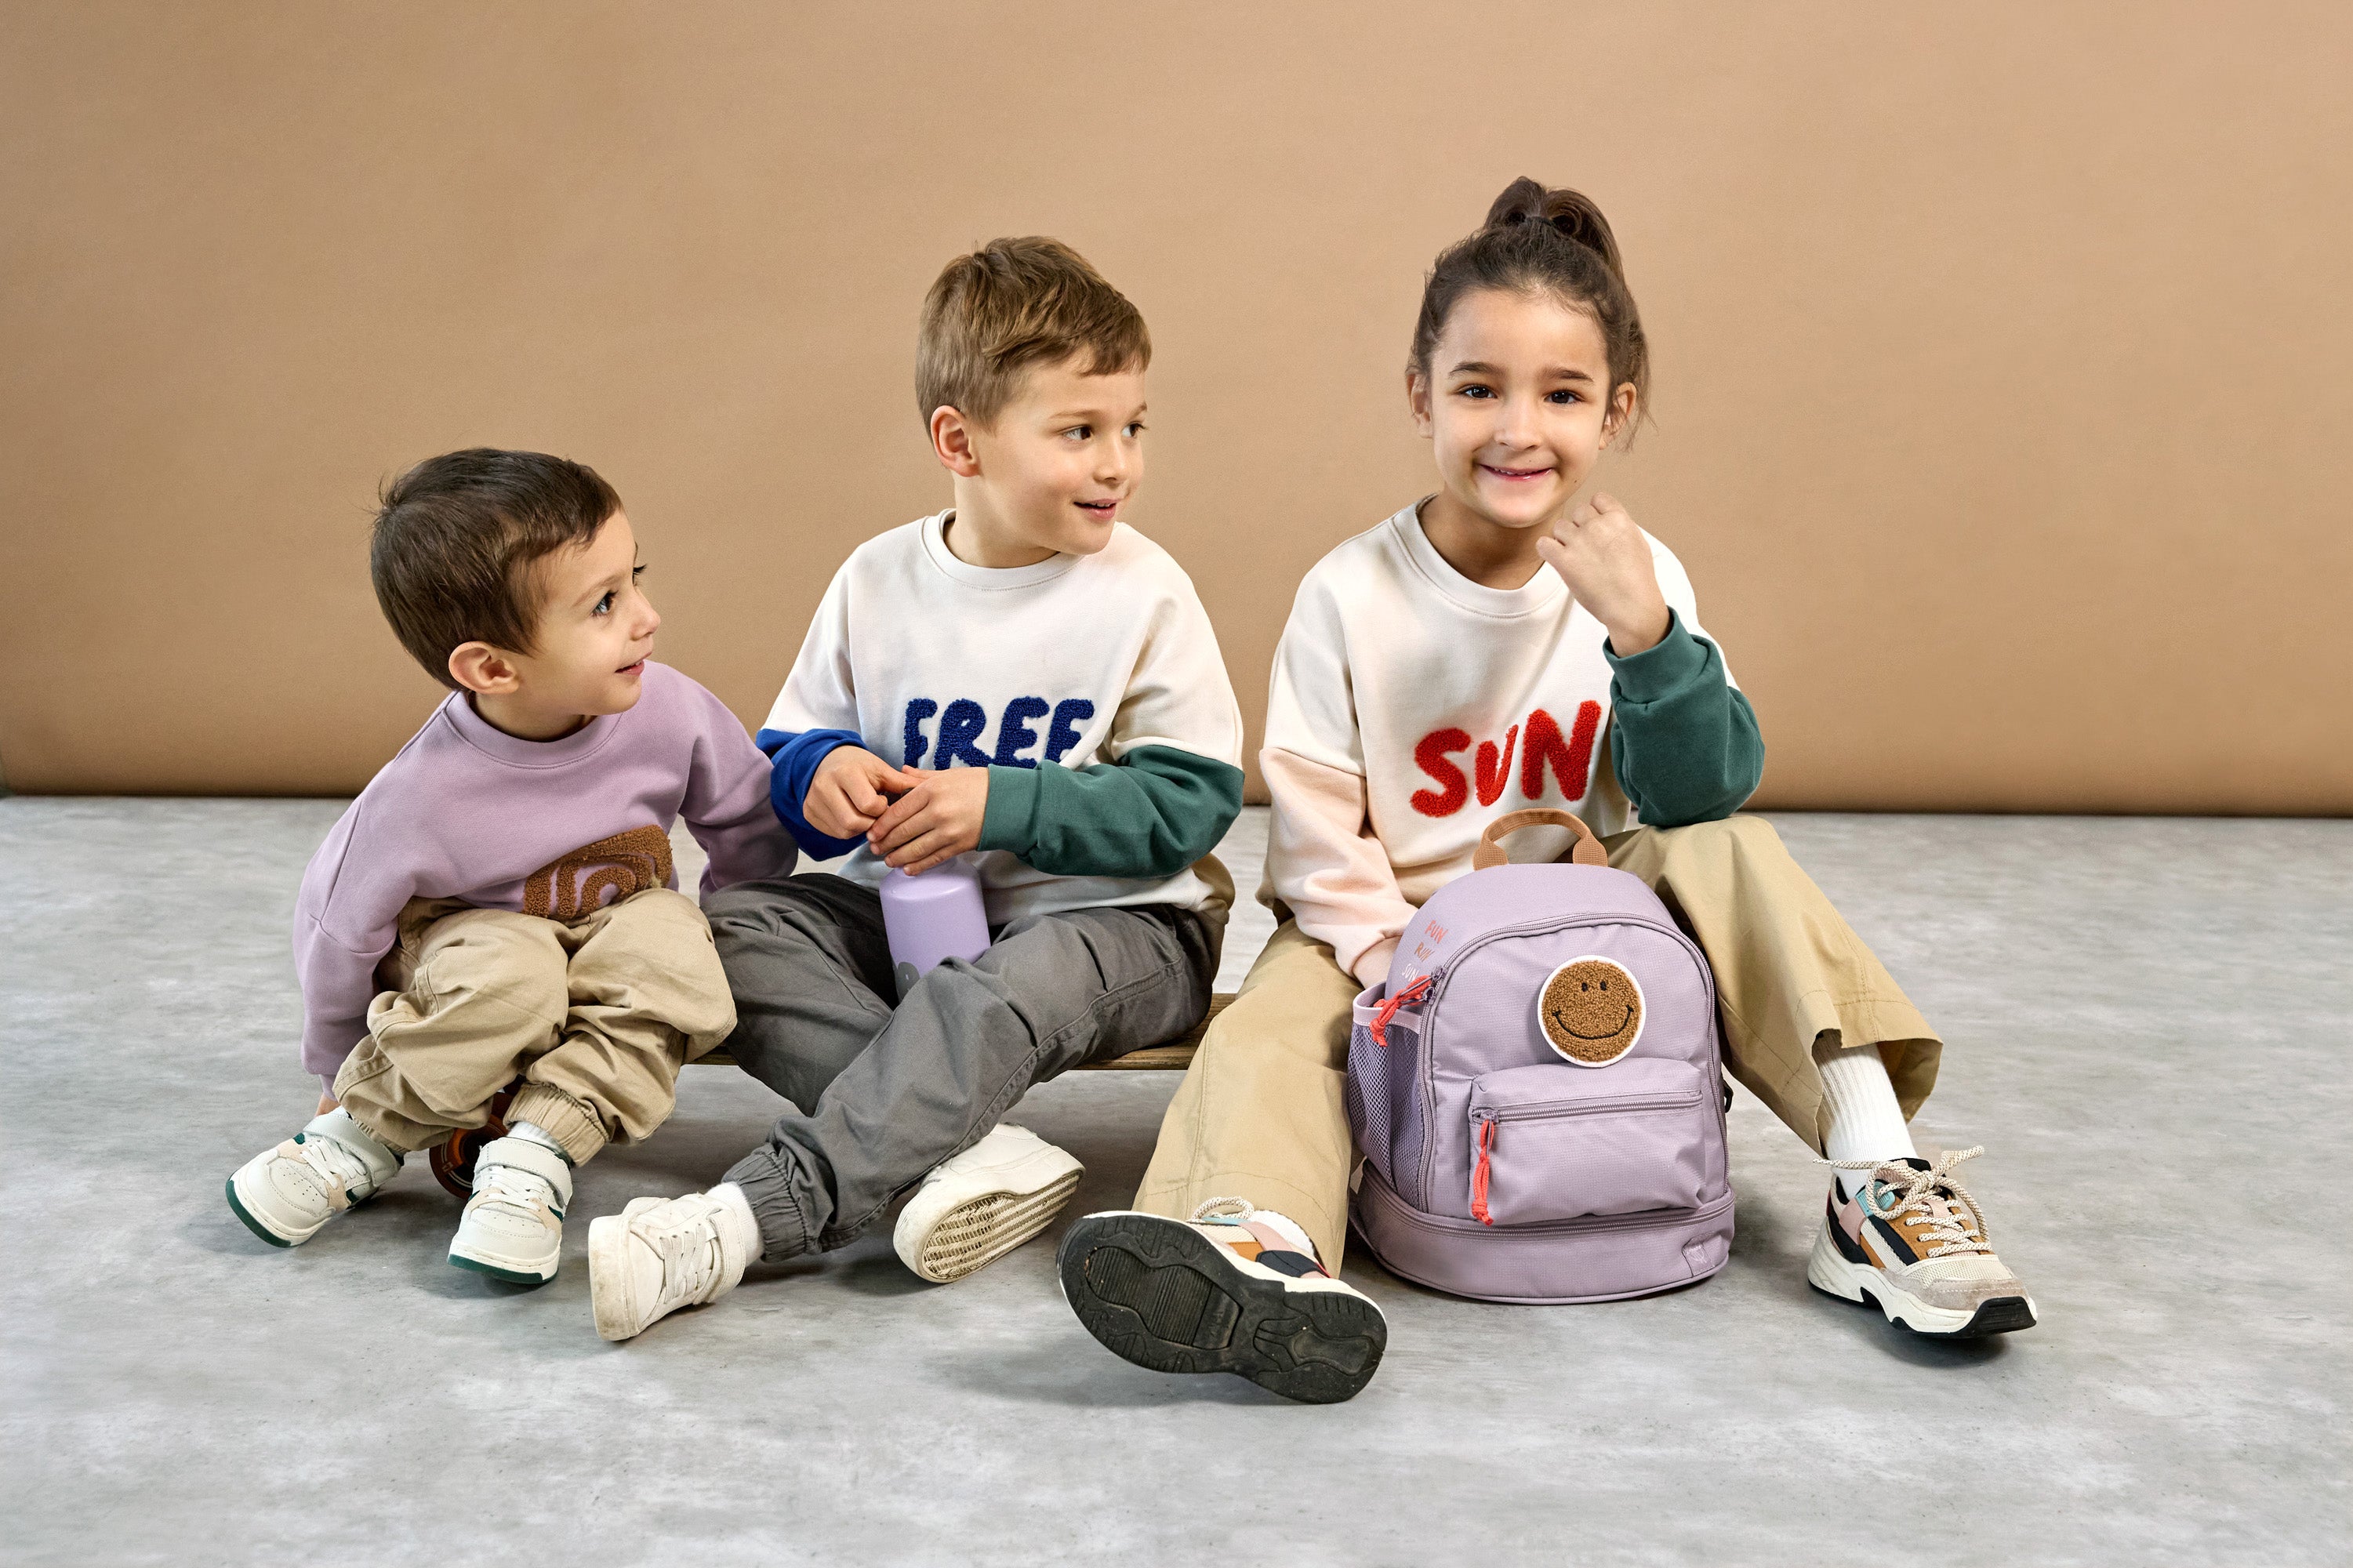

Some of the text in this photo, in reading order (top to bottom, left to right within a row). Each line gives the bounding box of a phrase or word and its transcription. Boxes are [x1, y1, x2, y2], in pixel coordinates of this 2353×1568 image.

[904, 696, 1095, 770] FREE
[1410, 700, 1602, 818] SUN
[1424, 920, 1449, 944] FUN
[1402, 963, 1419, 982] SUN
